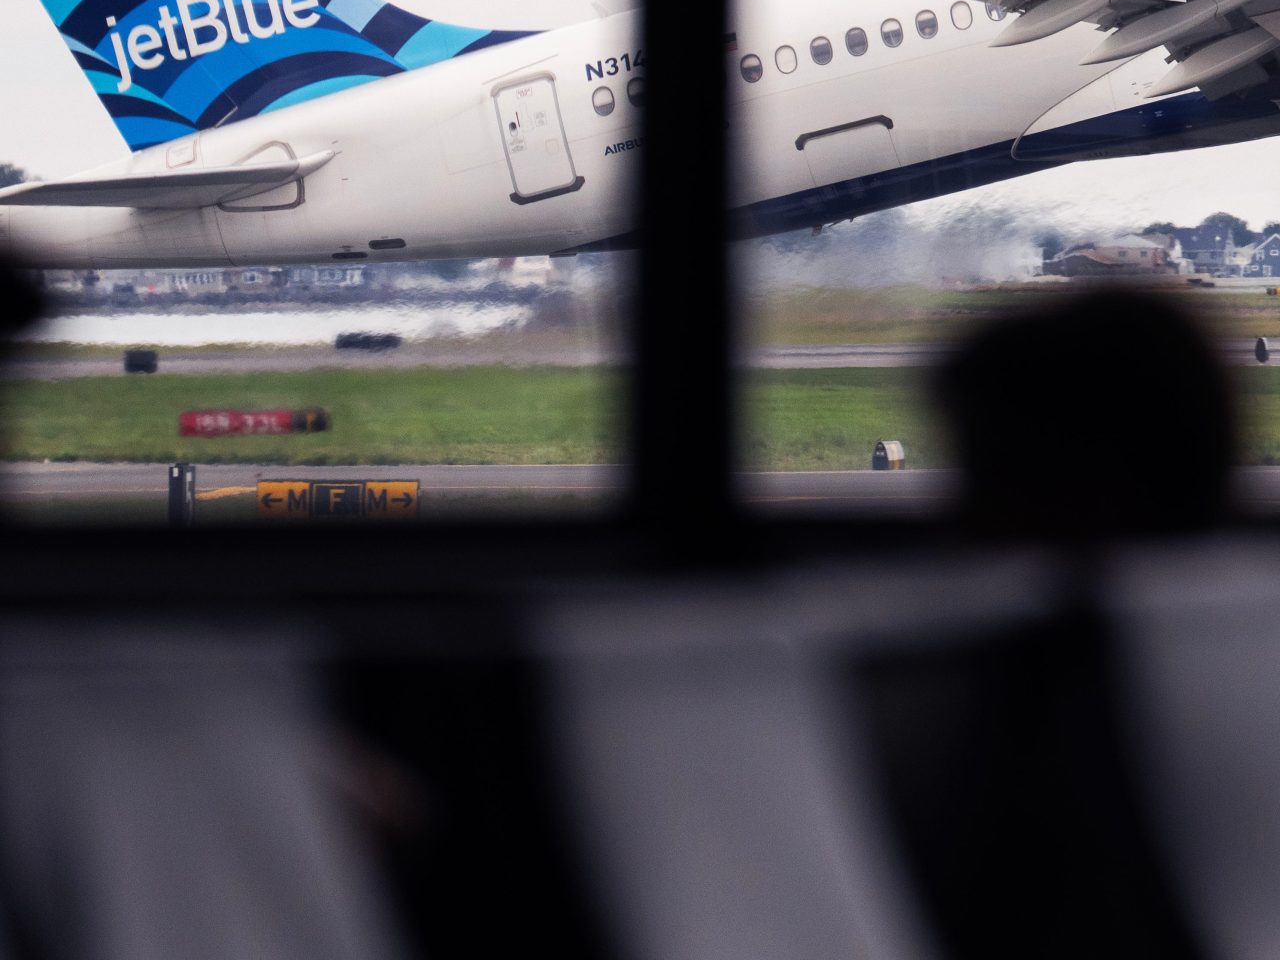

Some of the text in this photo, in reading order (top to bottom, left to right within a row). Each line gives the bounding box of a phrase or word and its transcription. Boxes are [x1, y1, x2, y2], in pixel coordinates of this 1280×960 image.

[287, 489, 388, 513] M F M
